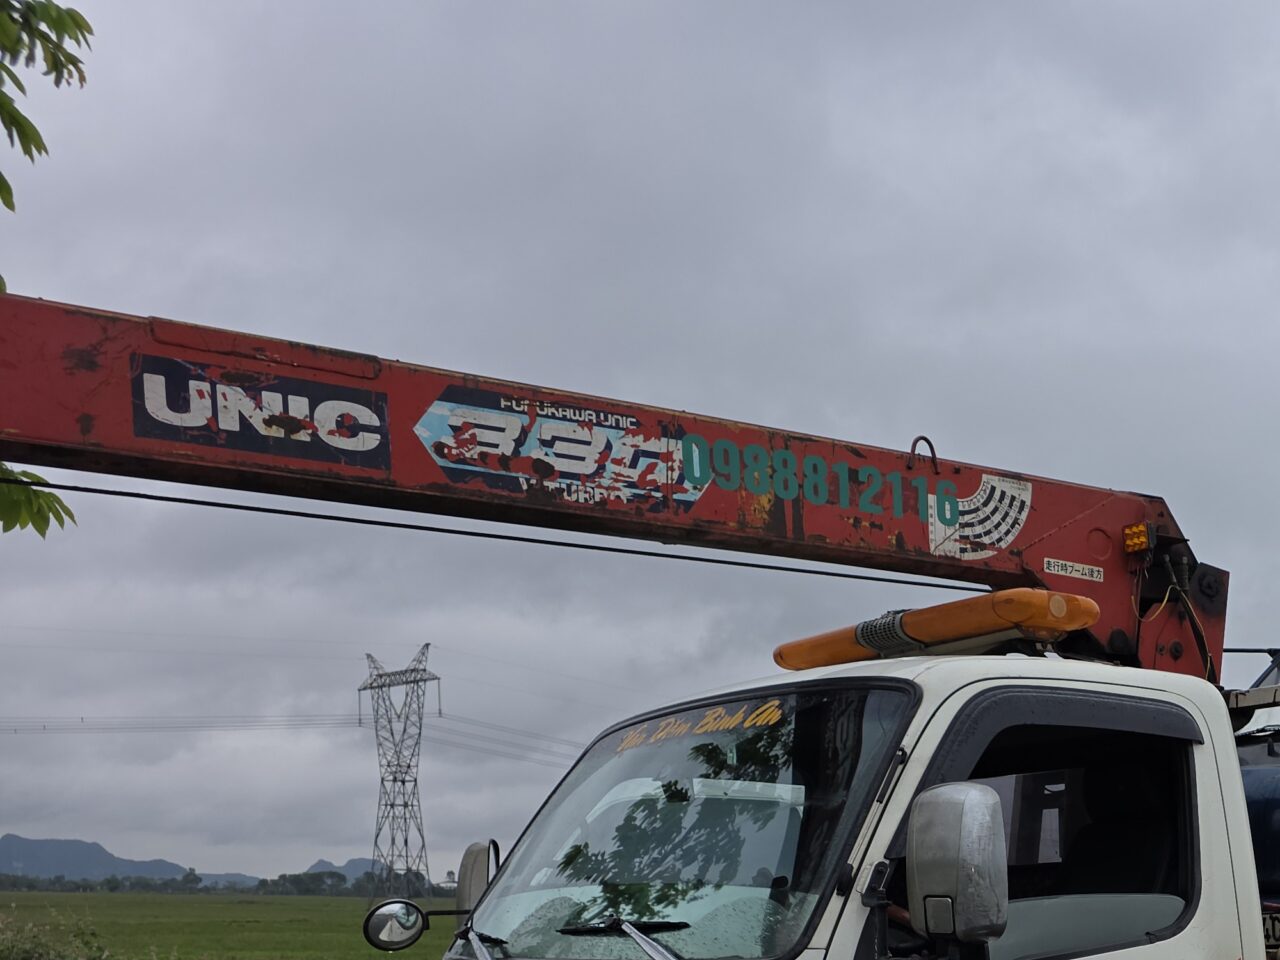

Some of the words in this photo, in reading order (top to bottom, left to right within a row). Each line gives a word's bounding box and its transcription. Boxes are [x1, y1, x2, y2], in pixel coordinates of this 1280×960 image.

[143, 372, 381, 452] UNIC
[600, 411, 638, 430] UNIC
[681, 434, 960, 526] 0988812116
[1045, 560, 1102, 580] 走行時ブーム後方
